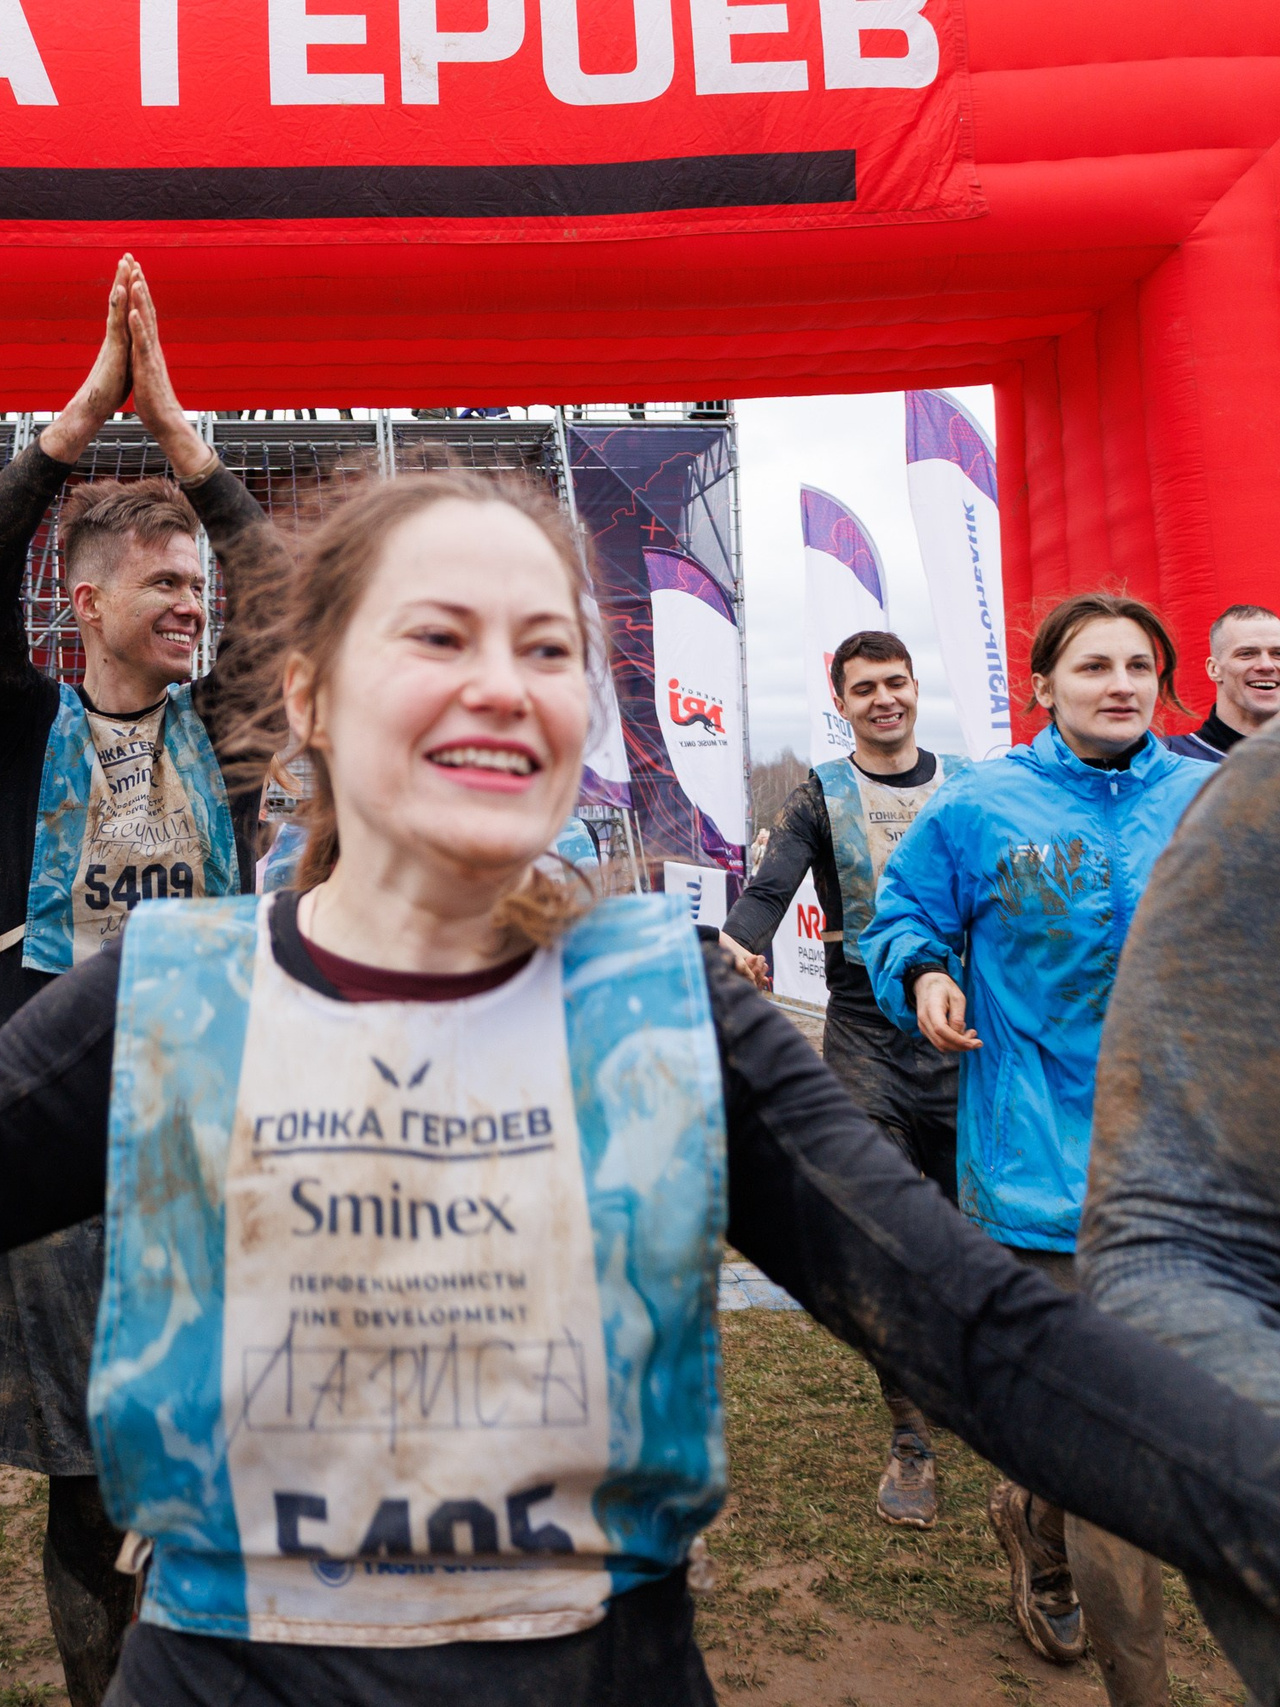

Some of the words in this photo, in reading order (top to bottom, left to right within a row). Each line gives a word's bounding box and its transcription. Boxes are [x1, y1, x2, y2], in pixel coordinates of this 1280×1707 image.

[97, 745, 127, 764] НКА
[868, 811, 905, 821] ГОНКА
[85, 862, 194, 911] 5409
[797, 903, 827, 941] NR
[799, 962, 825, 979] ЭНЕРД
[253, 1107, 384, 1143] ГОНКА
[401, 1106, 553, 1146] ГЕРОЕВ
[290, 1176, 516, 1240] Sminex
[289, 1270, 527, 1296] ПЕРФЕКЦИОНИСТЫ
[291, 1307, 341, 1327] FINE
[353, 1304, 529, 1329] DEVELOPMENT
